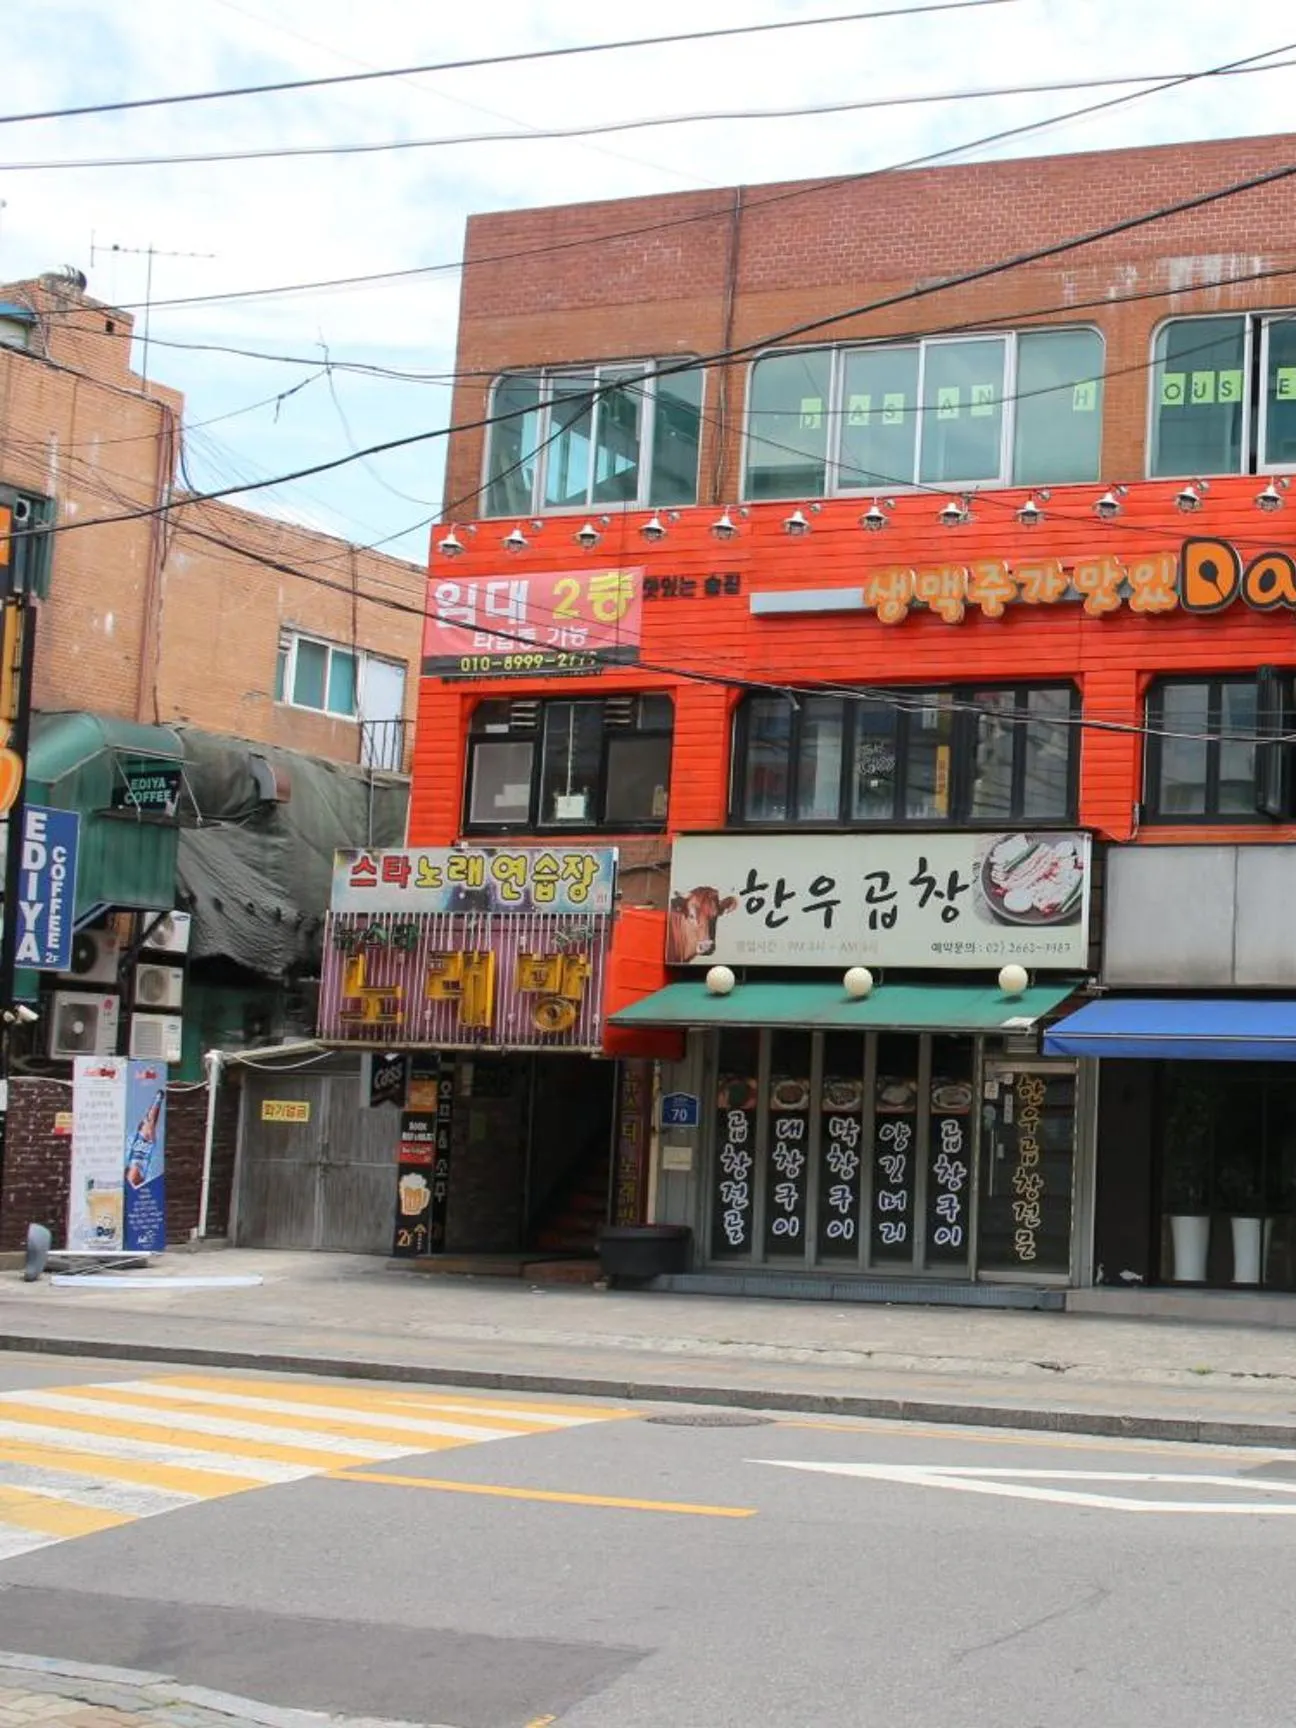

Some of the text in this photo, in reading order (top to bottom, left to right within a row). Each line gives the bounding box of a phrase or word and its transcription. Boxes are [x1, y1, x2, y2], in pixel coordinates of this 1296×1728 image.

[434, 571, 636, 628] 임대 2층
[547, 626, 589, 648] 가능
[124, 790, 172, 803] COFFEE
[130, 777, 166, 789] EDIYA
[15, 810, 48, 963] EDIYA
[47, 846, 67, 950] COFFEE
[45, 951, 60, 964] 2F
[340, 951, 592, 1032] 노래방
[671, 1108, 688, 1122] 70
[772, 1117, 804, 1237] 대창구이
[827, 1115, 860, 1240] 막창구이
[933, 1118, 967, 1247] 곱창구이
